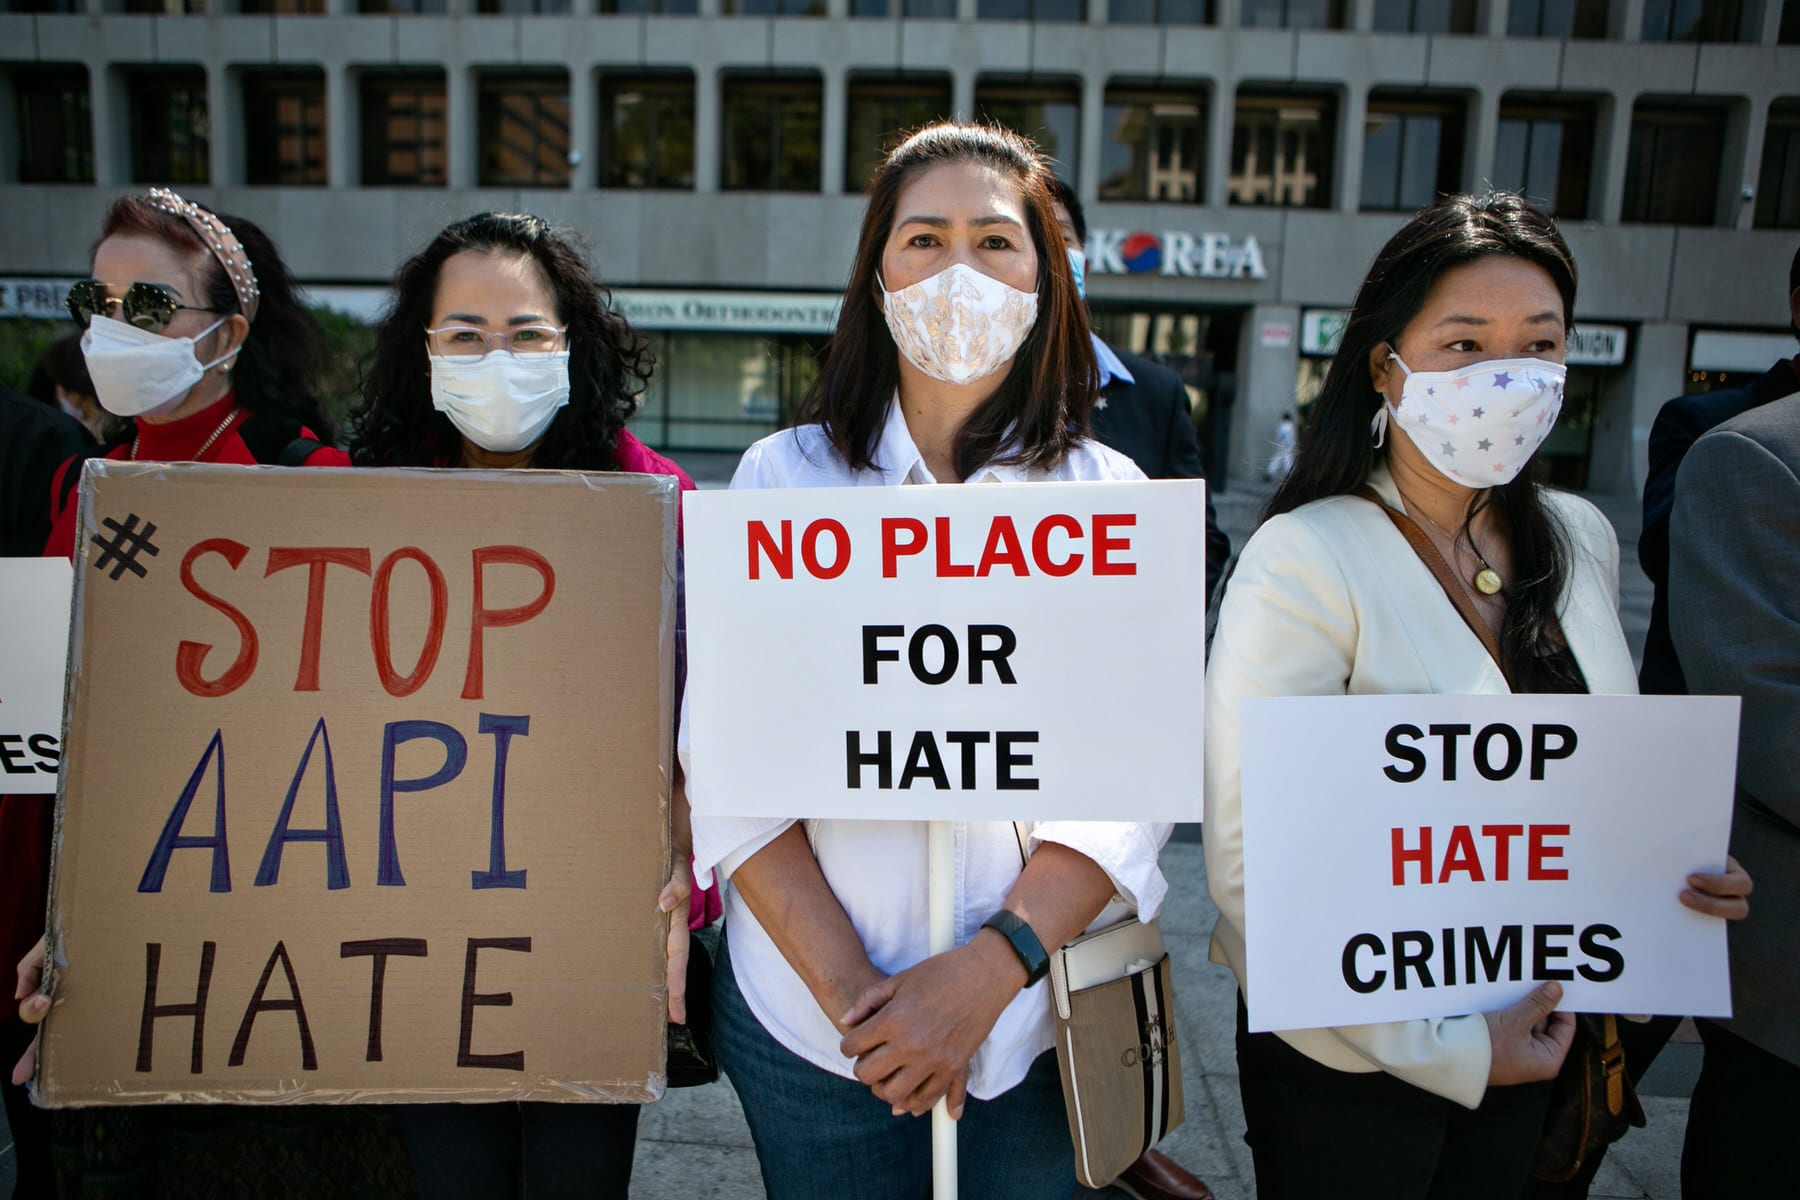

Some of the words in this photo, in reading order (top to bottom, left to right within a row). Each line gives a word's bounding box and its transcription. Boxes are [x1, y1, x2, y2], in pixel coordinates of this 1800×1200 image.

[1088, 229, 1267, 279] KOREA
[747, 518, 851, 580] NO
[881, 513, 1137, 578] PLACE
[862, 624, 1018, 686] FOR
[846, 730, 1040, 791] HATE
[1382, 722, 1578, 784] STOP
[137, 712, 531, 894] AAPI
[1391, 824, 1571, 887] HATE
[1341, 923, 1625, 994] CRIMES
[135, 936, 532, 1075] HATE
